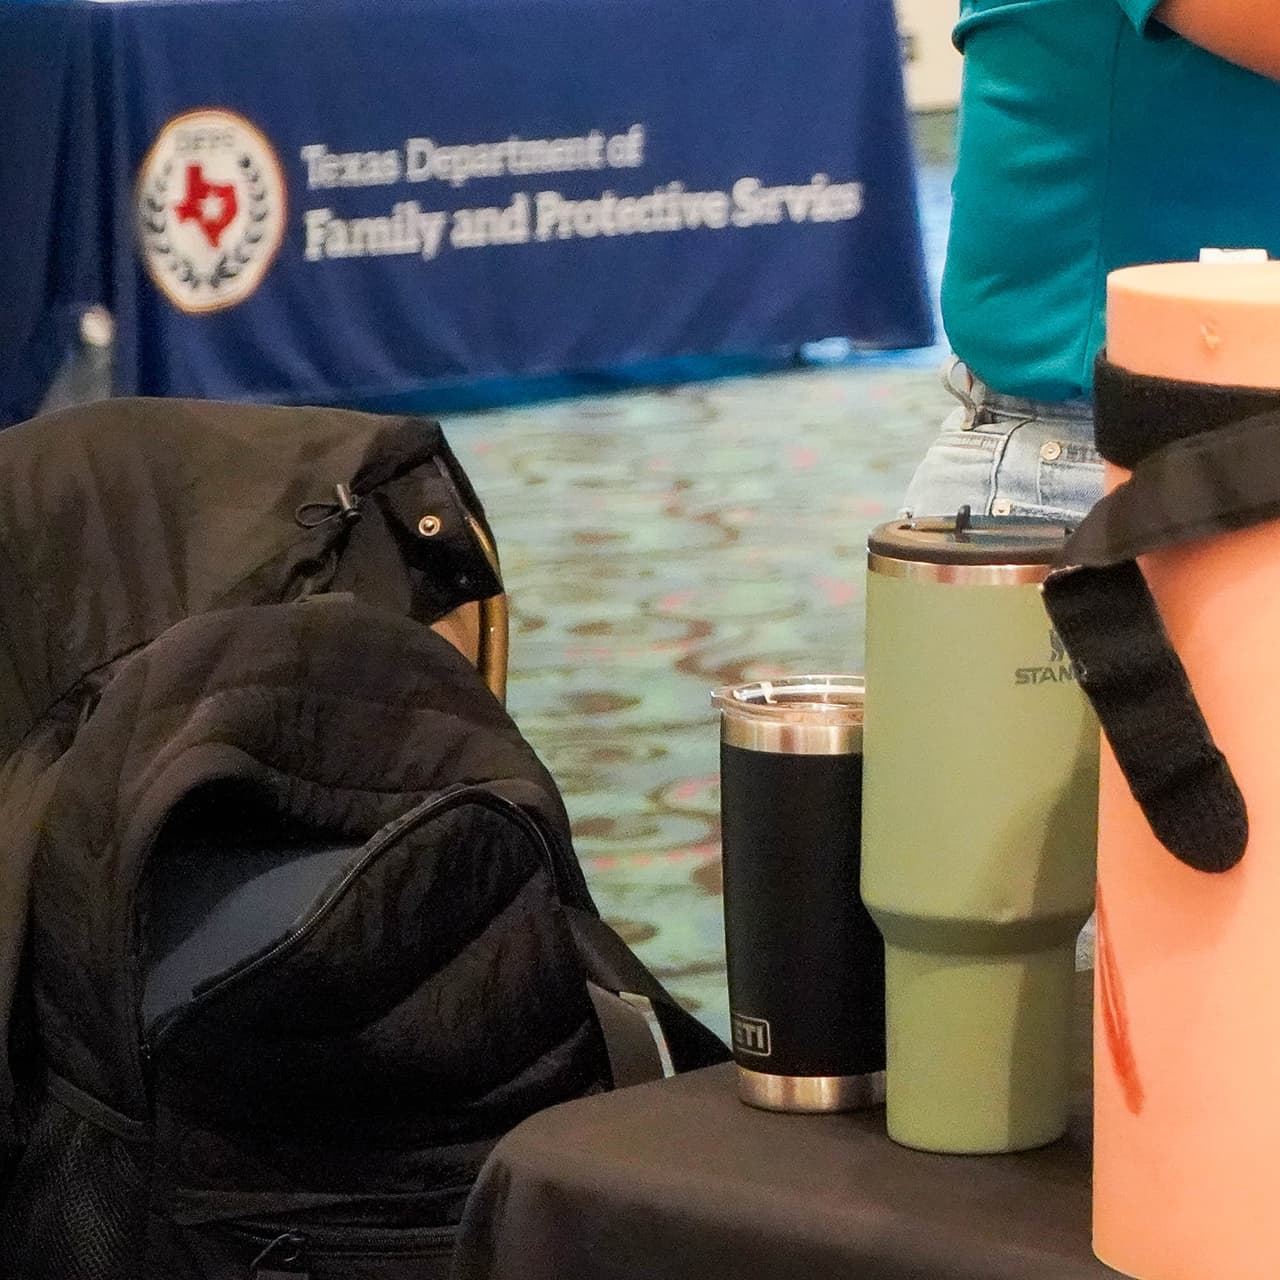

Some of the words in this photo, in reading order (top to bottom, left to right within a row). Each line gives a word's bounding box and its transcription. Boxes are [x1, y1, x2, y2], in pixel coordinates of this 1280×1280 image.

[302, 144, 400, 189] Texas
[405, 134, 604, 187] Department
[607, 123, 645, 168] of
[304, 200, 448, 261] Family
[451, 191, 530, 249] and
[534, 181, 729, 242] Protective
[1014, 665, 1073, 685] STAN
